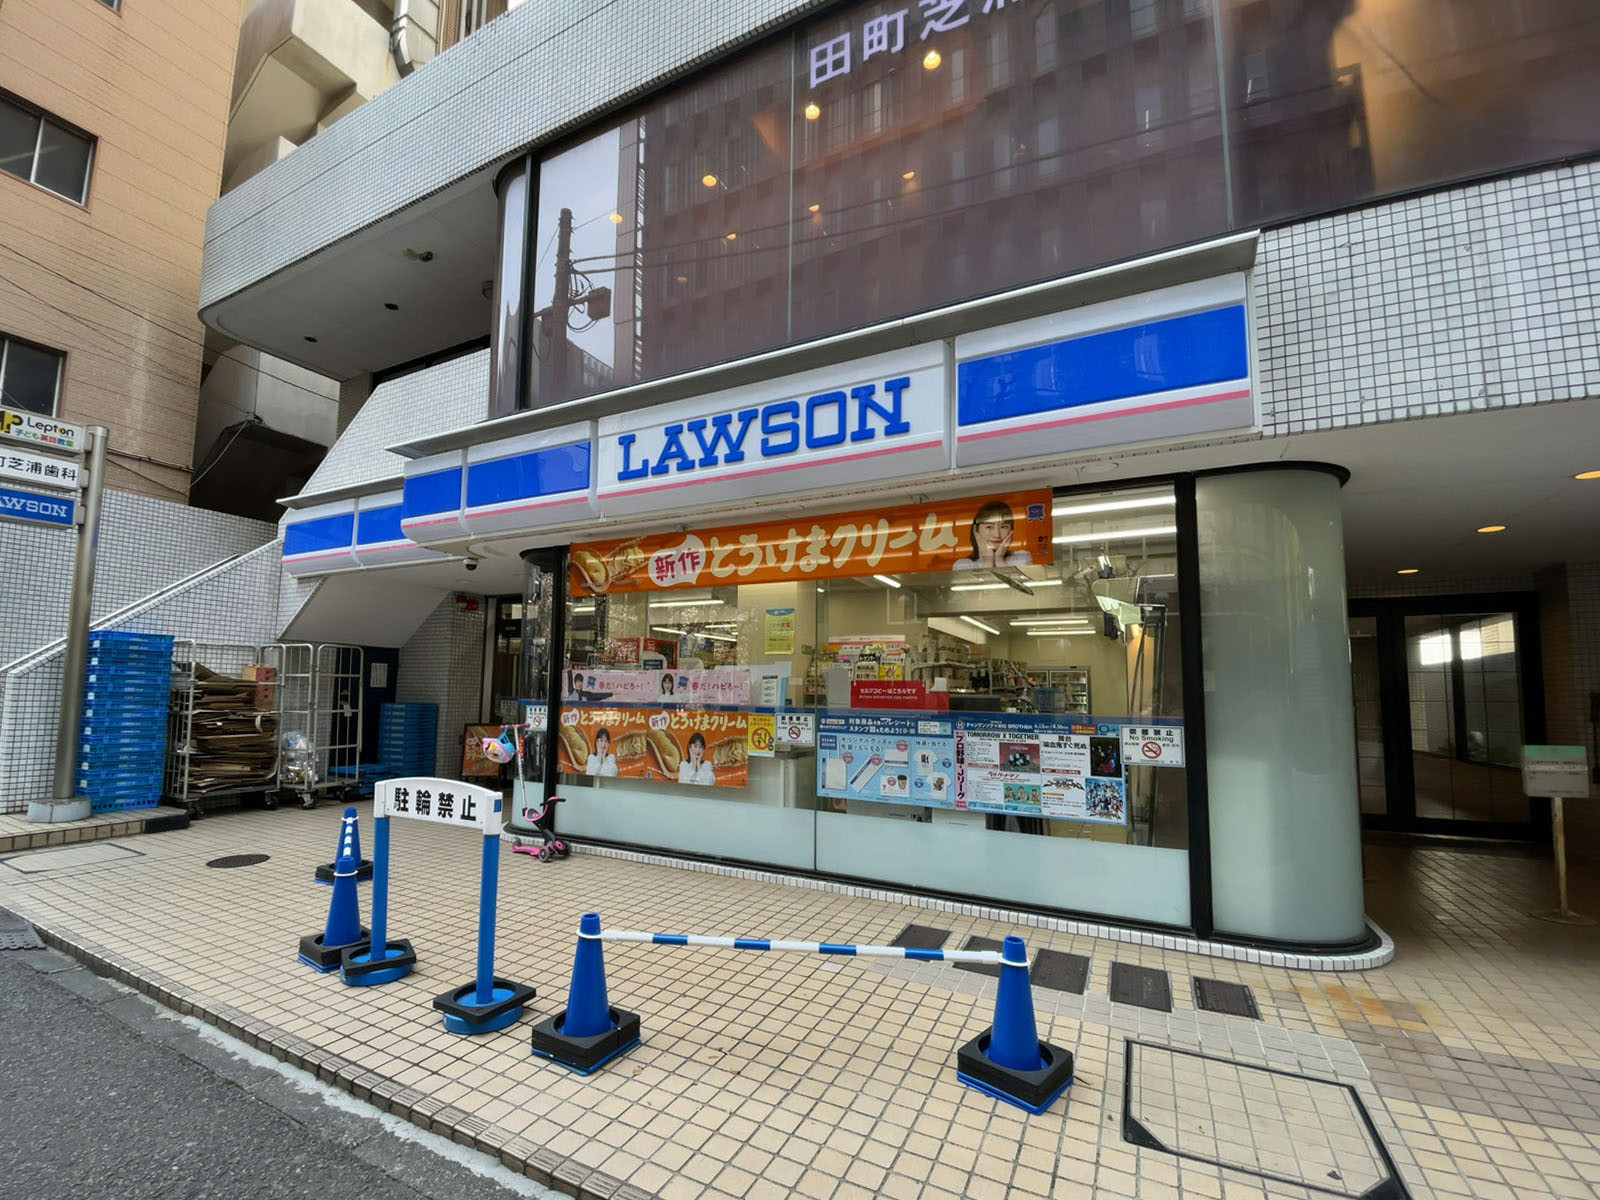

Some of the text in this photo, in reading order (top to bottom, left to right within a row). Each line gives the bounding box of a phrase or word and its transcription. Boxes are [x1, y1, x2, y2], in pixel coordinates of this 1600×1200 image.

[810, 0, 1018, 89] 田町芝
[27, 417, 74, 437] Lepton
[617, 376, 911, 481] LAWSON
[654, 549, 702, 581] 新作
[562, 712, 579, 723] 新作
[651, 715, 668, 727] 新作
[1141, 735, 1175, 743] Smoking
[393, 787, 477, 821] 駐輪禁止
